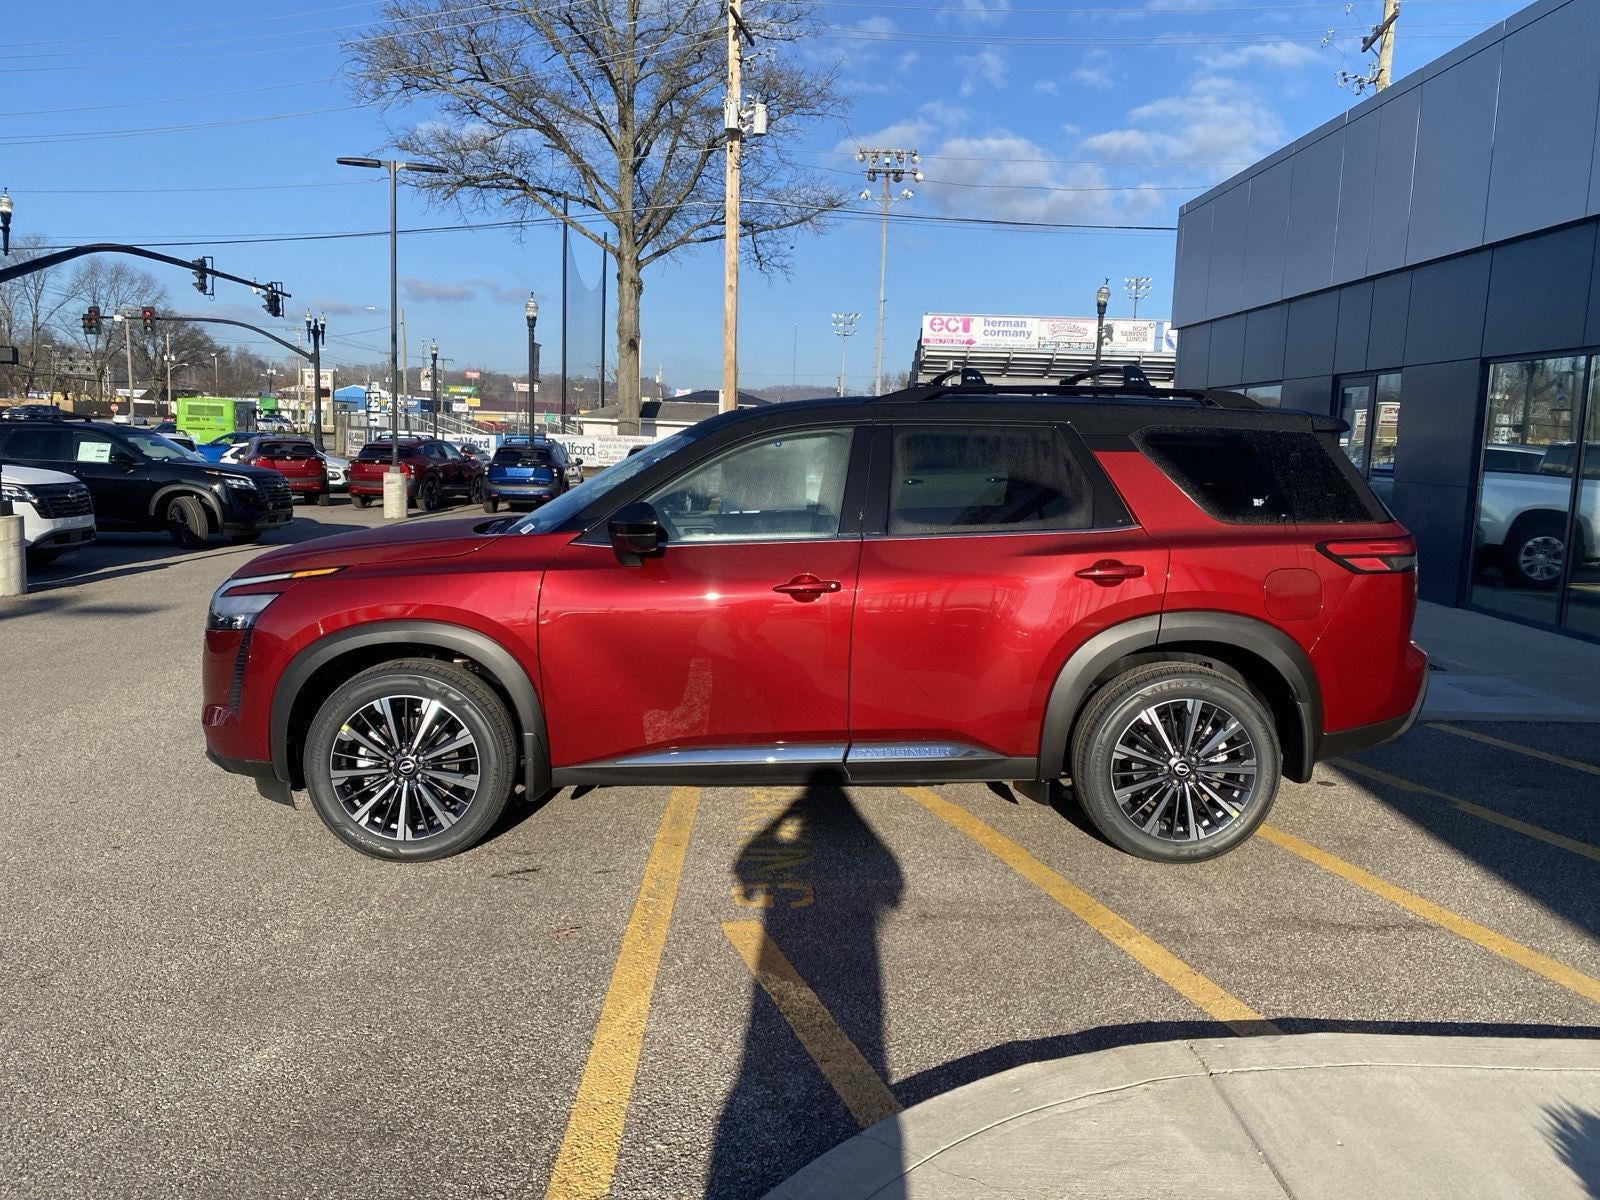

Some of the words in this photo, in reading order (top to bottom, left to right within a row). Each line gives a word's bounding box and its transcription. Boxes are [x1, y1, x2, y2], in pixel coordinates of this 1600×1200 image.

[983, 318, 1027, 327] herman
[983, 328, 1033, 339] cormany
[367, 397, 379, 408] 25
[855, 746, 951, 757] PATHFINDER
